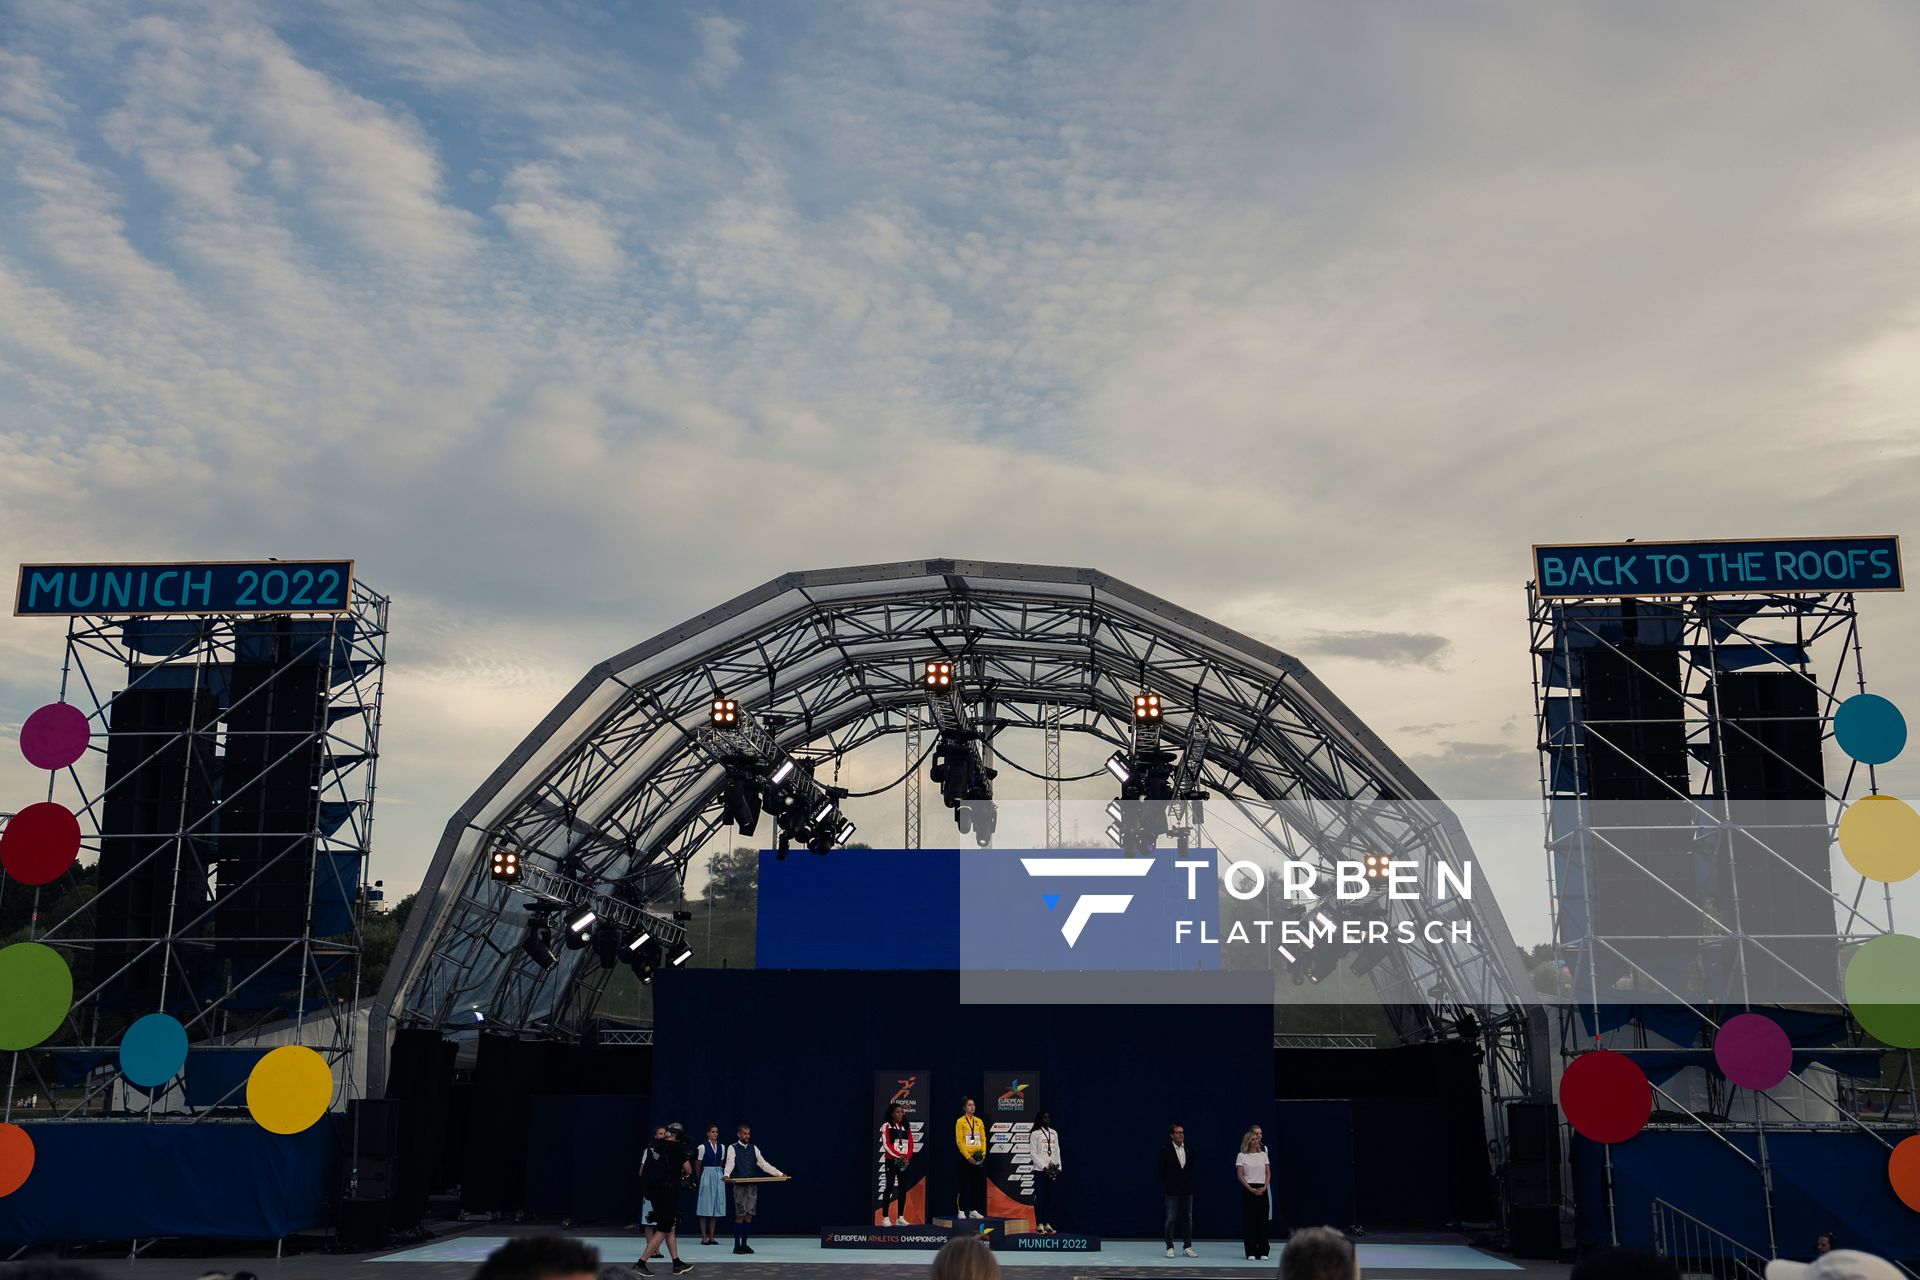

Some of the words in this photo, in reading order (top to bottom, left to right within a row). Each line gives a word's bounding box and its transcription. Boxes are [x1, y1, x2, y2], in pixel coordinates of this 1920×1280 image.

[1543, 555, 1639, 587] BACK
[1646, 554, 1689, 584] TO
[1698, 551, 1767, 583] THE
[1775, 549, 1892, 581] ROOFS
[28, 570, 212, 608] MUNICH
[235, 568, 340, 605] 2022
[834, 1234, 868, 1243] EUROPEAN
[868, 1235, 900, 1243] ATHLETICS
[900, 1235, 948, 1243] CHAMPIONSHIPS
[1018, 1238, 1060, 1249] MUNICH
[1062, 1238, 1088, 1249] 2022
